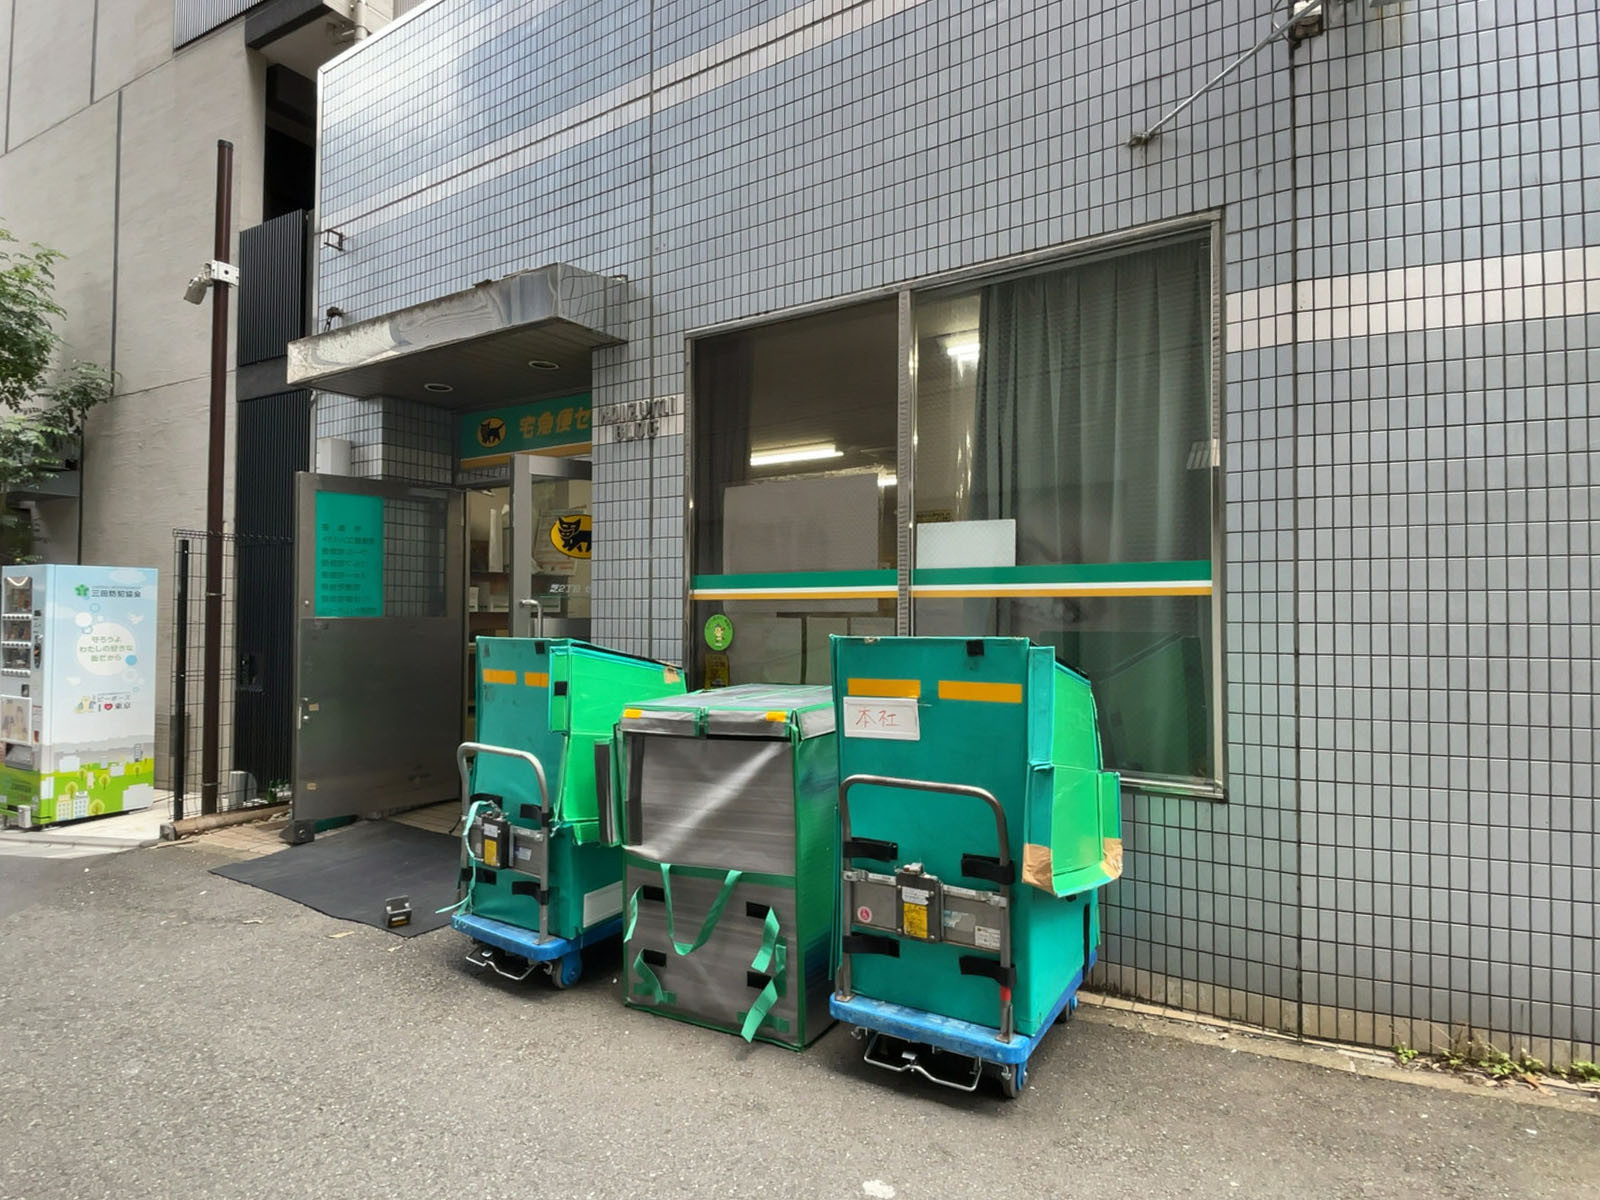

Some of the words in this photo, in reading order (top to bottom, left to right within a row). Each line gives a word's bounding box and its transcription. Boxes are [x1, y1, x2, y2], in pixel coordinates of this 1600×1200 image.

[91, 589, 141, 598] 三田防犯協会
[91, 636, 121, 644] 守ろうよ
[79, 645, 134, 653] わたしの好きな
[855, 709, 900, 729] 本社
